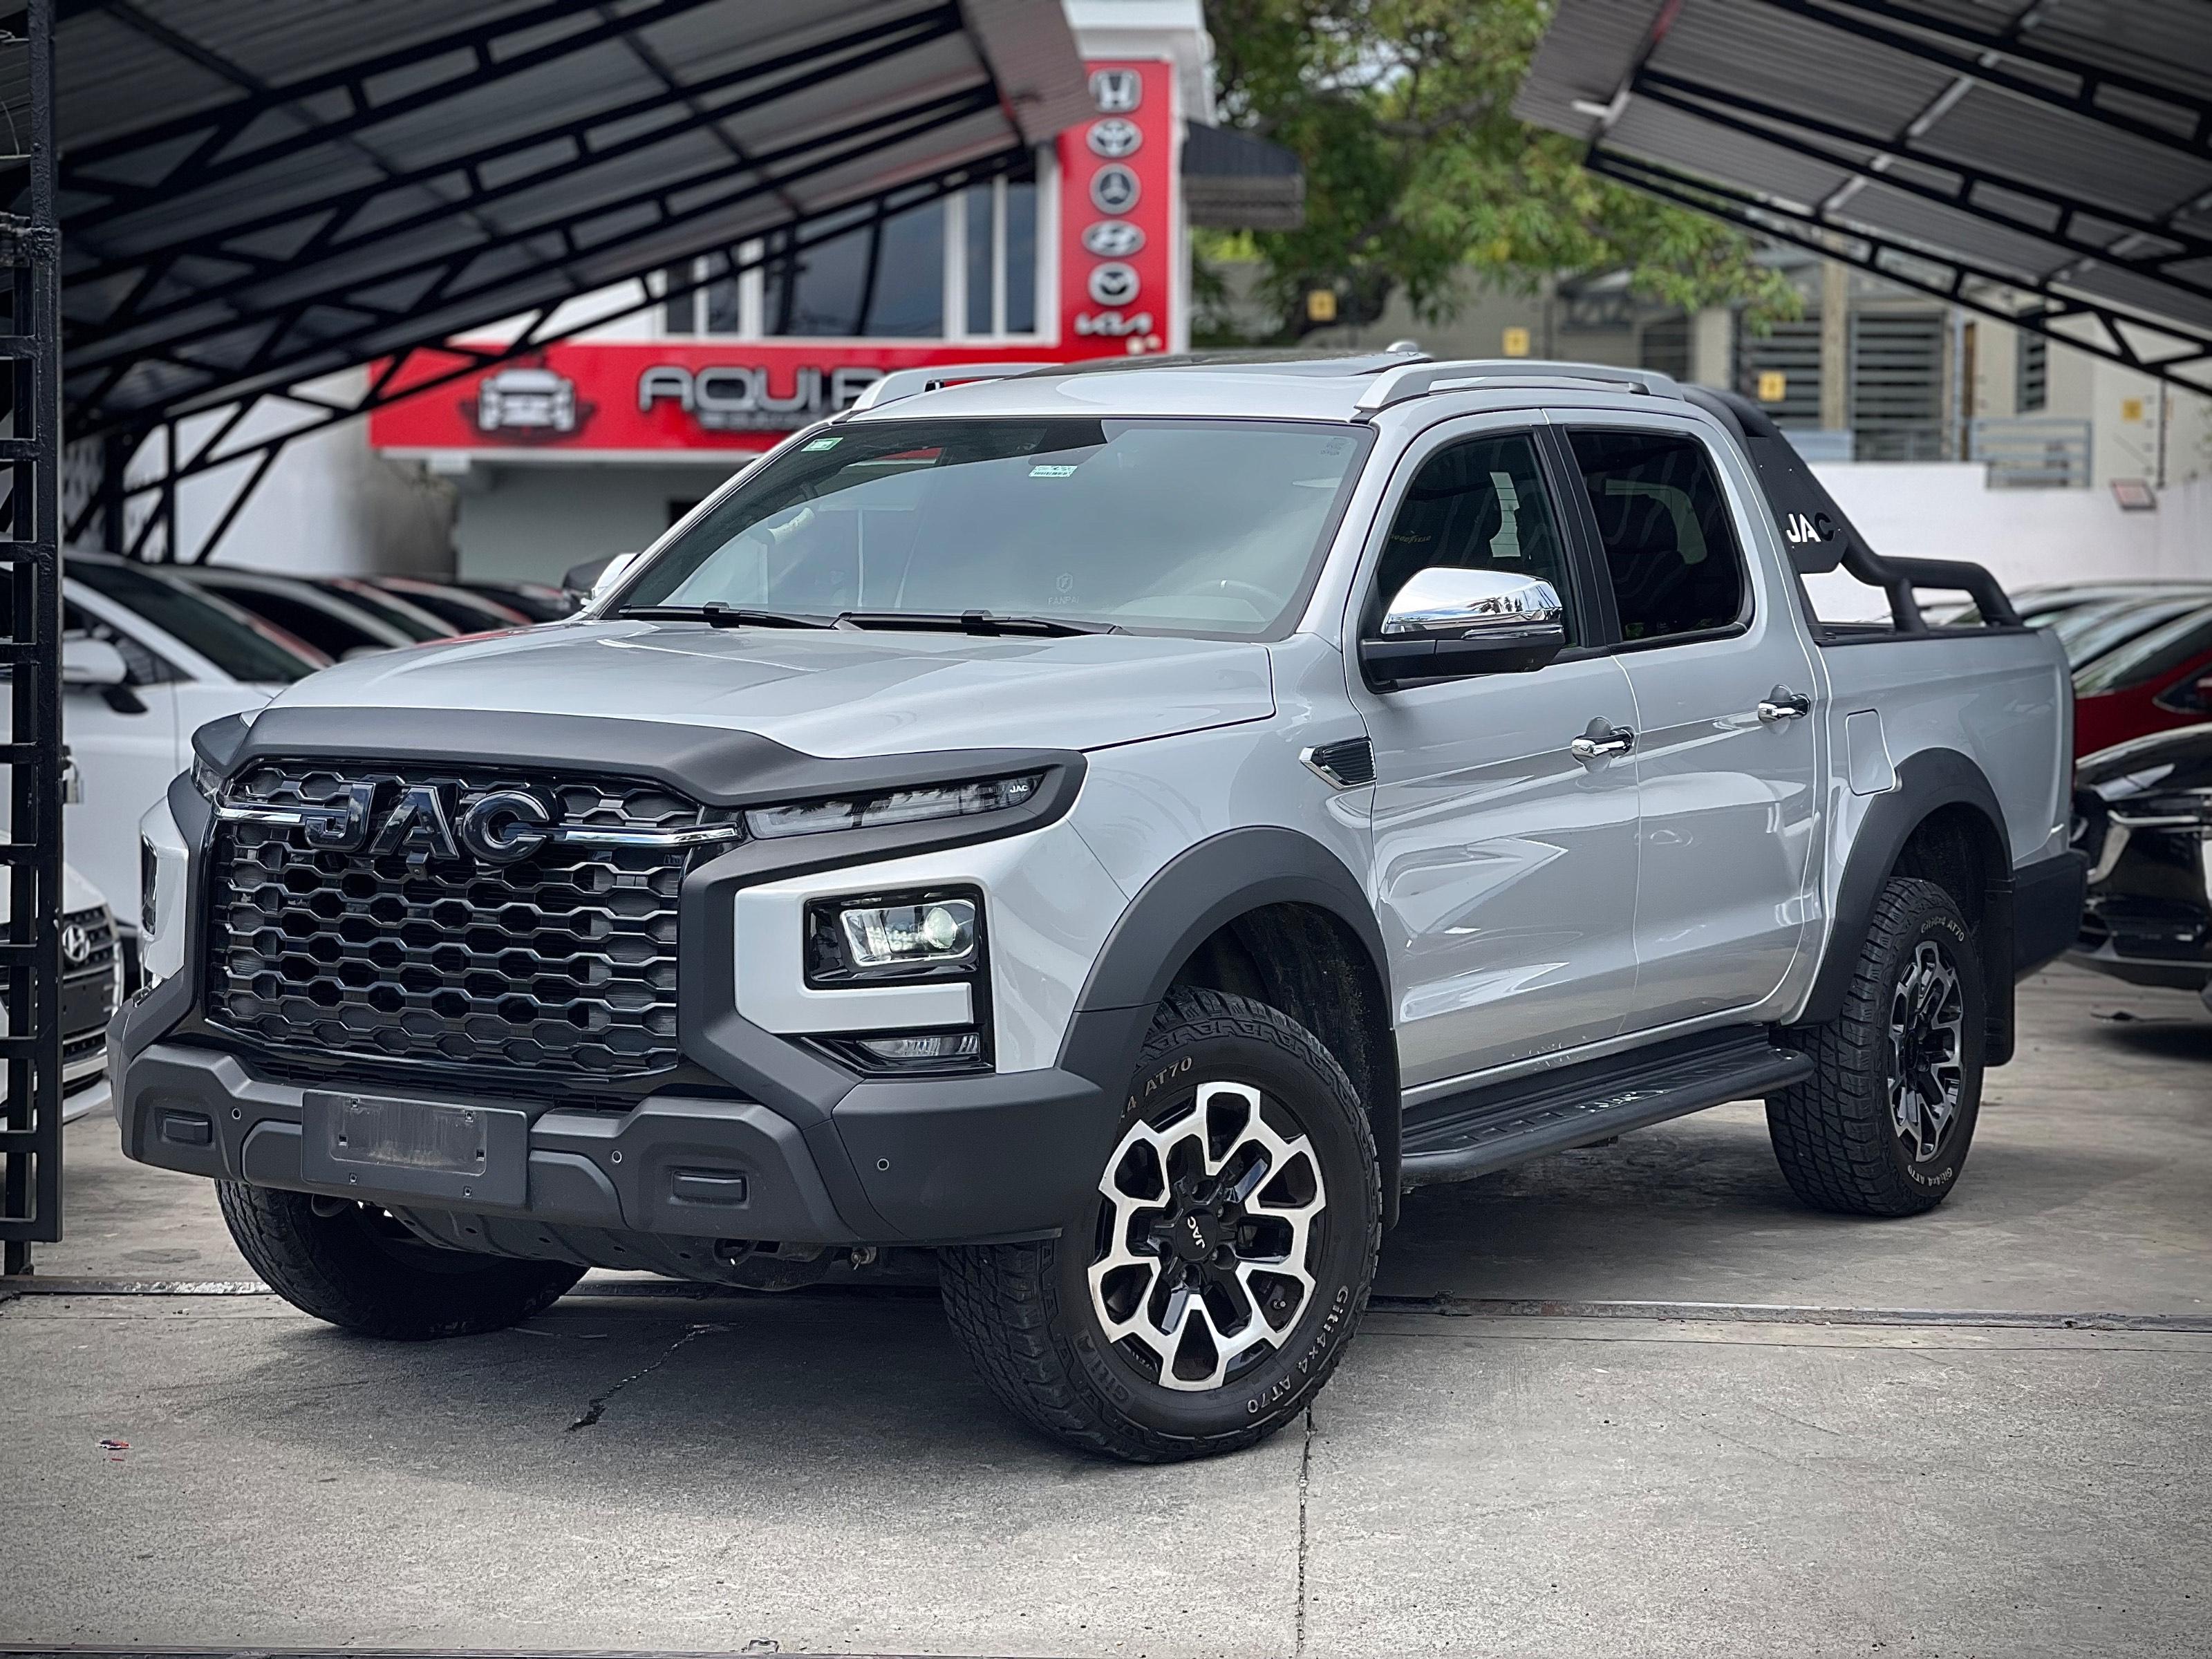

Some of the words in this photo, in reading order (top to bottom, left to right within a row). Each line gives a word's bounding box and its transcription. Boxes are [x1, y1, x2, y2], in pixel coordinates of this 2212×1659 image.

[1786, 512, 1835, 543] JAC
[1009, 785, 1028, 793] JAC
[305, 781, 550, 863] JAC
[1946, 919, 1965, 941] AT70
[1145, 1056, 1192, 1097] AT70
[1908, 1165, 1925, 1185] AT70
[1187, 1216, 1206, 1248] JAC
[1297, 1285, 1349, 1374] Giti4x4
[1247, 1374, 1291, 1414] AT70
